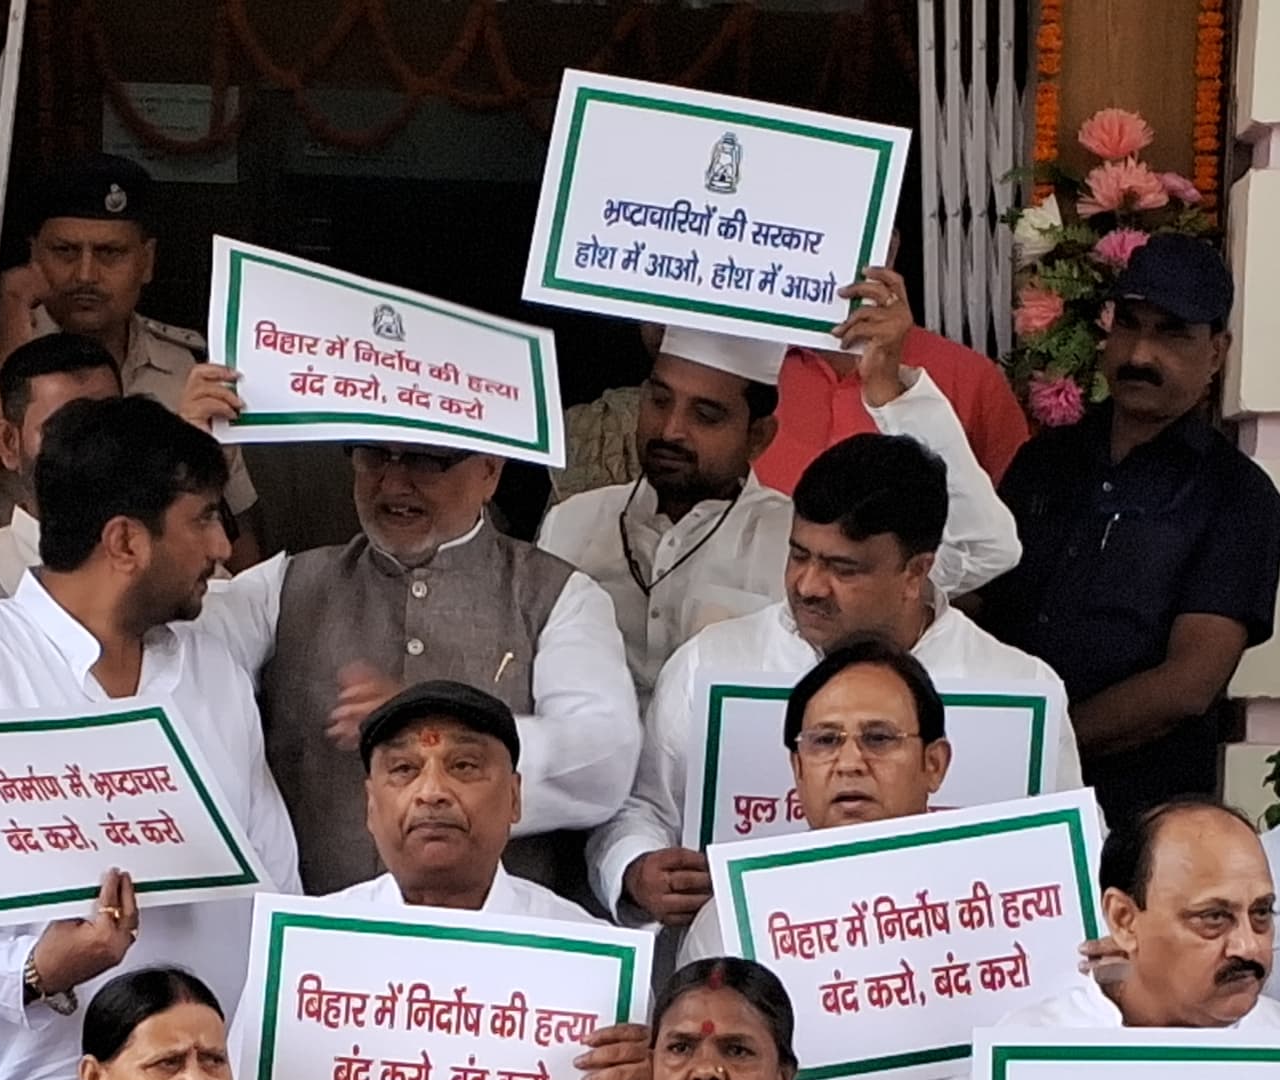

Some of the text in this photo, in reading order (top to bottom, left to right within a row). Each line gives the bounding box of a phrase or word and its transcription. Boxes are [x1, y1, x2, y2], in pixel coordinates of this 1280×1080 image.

[604, 200, 824, 254] भ्रष्टाचारियों की सरकार
[575, 235, 836, 304] होश में आओ, होश में आओ
[256, 321, 320, 355] बिहार
[326, 336, 349, 359] में
[428, 352, 461, 384] की
[291, 366, 483, 419] बंद करो, बंद करो
[62, 765, 91, 798] में
[89, 766, 177, 802] भ्रष्टाचार
[1, 810, 185, 853] बंद करो, बंद करो
[734, 796, 780, 834] पुल
[769, 881, 1061, 959] बिहार में निर्दोष की हत्या
[820, 942, 1030, 1014] बंद करो, बंद करो
[297, 974, 599, 1047] बिहार में निर्दोष की हत्या
